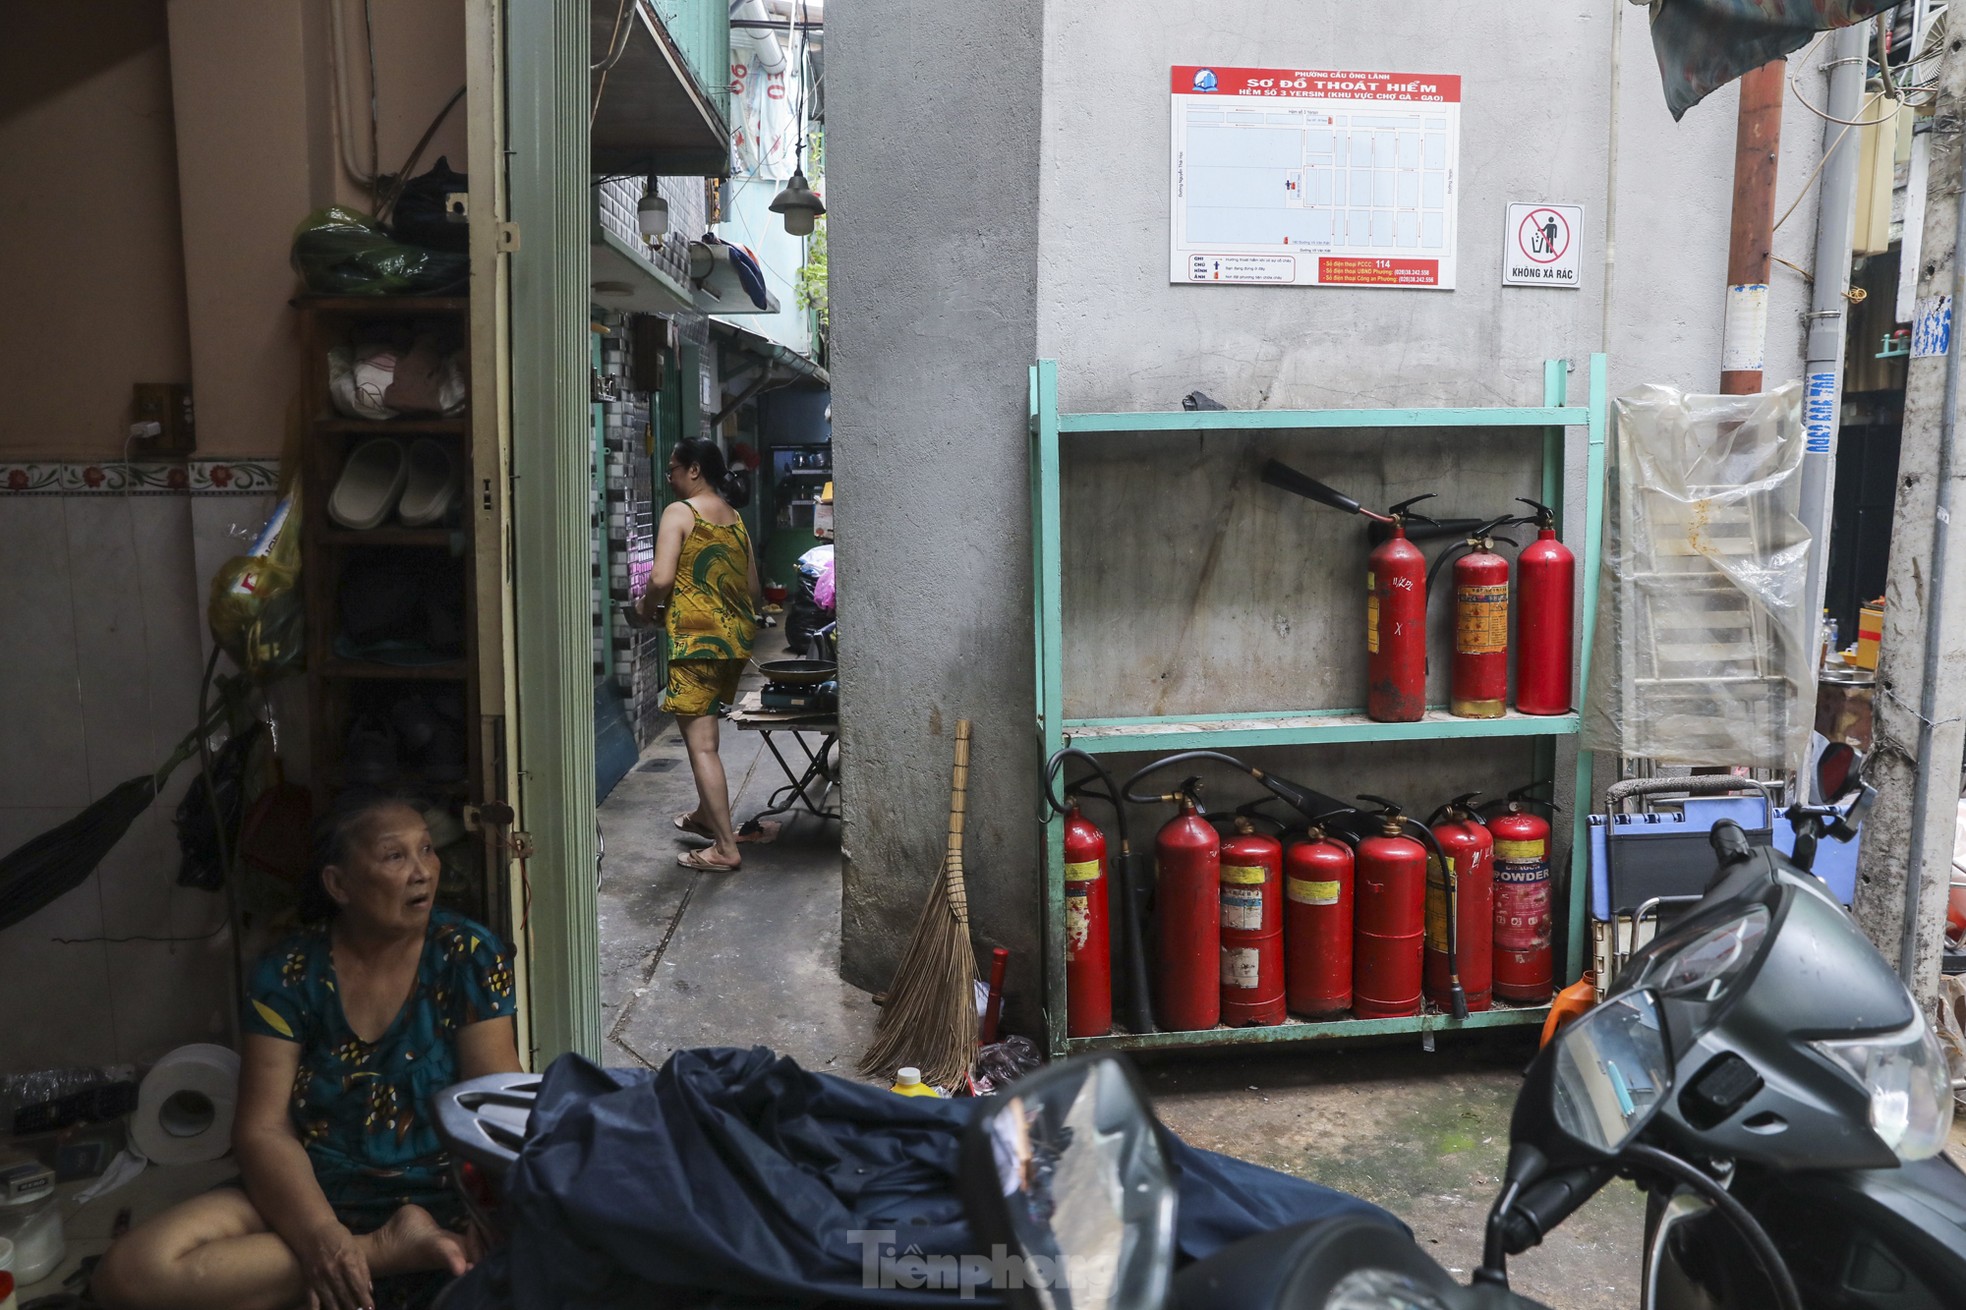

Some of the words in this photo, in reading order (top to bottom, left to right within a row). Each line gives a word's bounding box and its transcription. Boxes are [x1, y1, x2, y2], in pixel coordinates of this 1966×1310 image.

[1247, 78, 1274, 88] SƠ
[1279, 78, 1307, 89] ĐỒ
[1314, 80, 1379, 91] THOÁT
[1387, 80, 1437, 93] HIỂM
[1264, 88, 1278, 96] SỐ
[1354, 92, 1374, 100] VỰC
[1376, 93, 1397, 101] CHỢ
[1399, 92, 1411, 100] GÀ
[1376, 260, 1391, 268] 114
[1512, 265, 1541, 278] KHÔNG
[1543, 267, 1554, 278] XẢ
[1556, 268, 1573, 279] RÁC
[1494, 869, 1550, 883] POWDER
